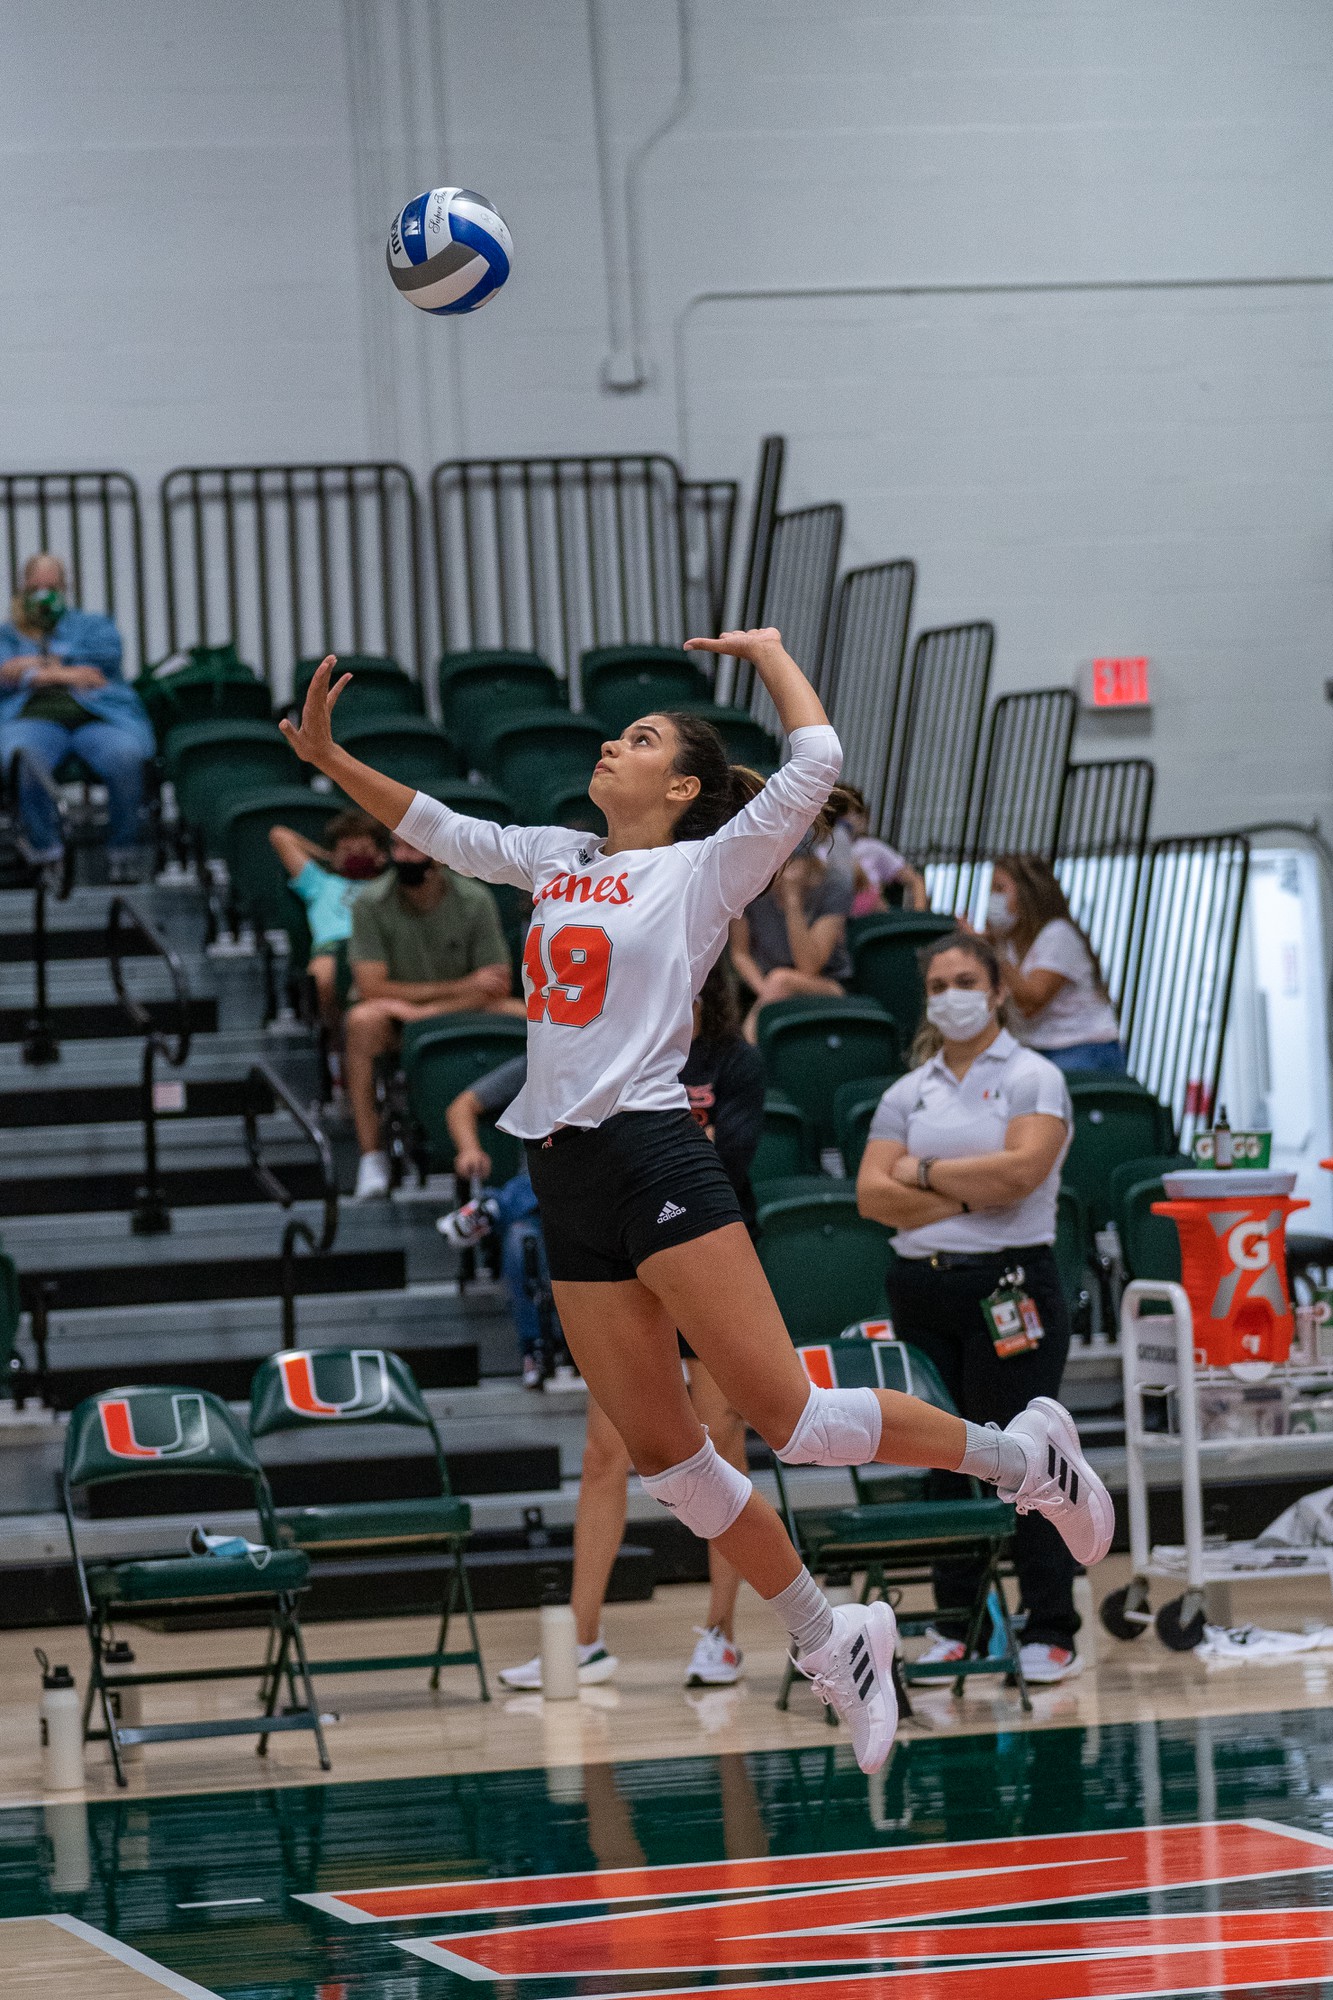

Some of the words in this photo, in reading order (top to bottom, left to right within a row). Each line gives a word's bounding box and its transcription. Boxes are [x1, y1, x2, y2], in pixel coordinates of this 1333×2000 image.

[523, 924, 613, 1028] 19
[656, 1206, 687, 1224] adidas
[1228, 1220, 1269, 1270] G
[277, 1350, 390, 1420] U
[98, 1393, 211, 1460] U
